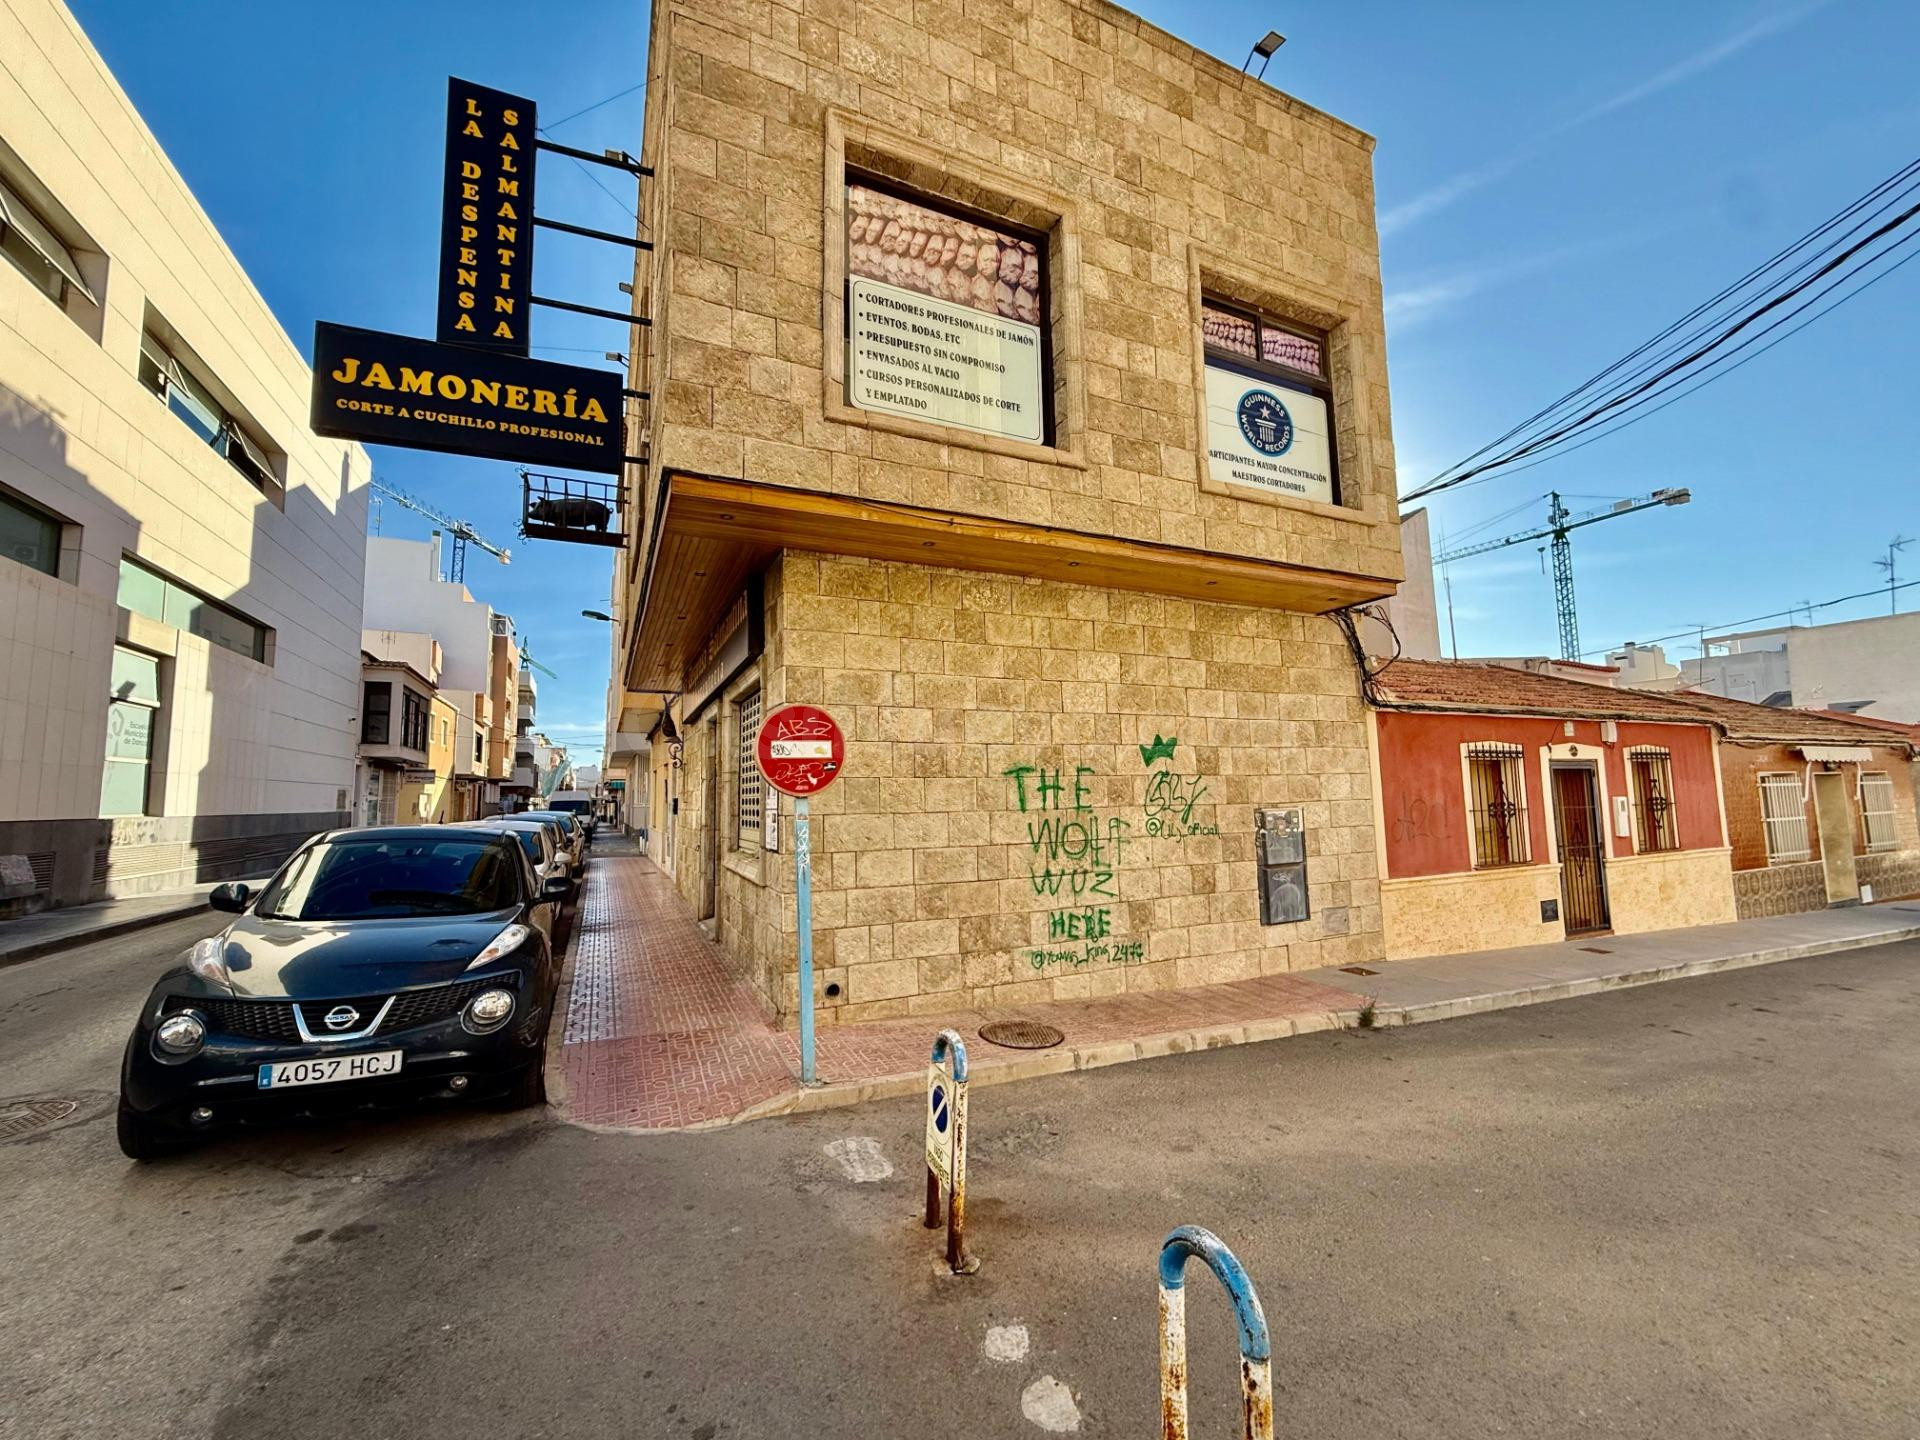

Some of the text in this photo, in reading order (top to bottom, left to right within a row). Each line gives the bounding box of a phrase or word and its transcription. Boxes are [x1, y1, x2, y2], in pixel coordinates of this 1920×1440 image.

[455, 98, 483, 333] LA DESPENSA
[494, 108, 520, 340] SALMANTINA
[866, 293, 1034, 347] CORTADORES PROFESIONALES DE JAMÓN
[866, 330, 1006, 374] PRESUPUESTO SIN COMPROMISO
[944, 332, 961, 345] ETC
[866, 350, 960, 381] ENVASADOS AL VACIO
[332, 357, 609, 424] JAMONERÍA
[865, 388, 928, 410] Y EMPLATADO
[866, 369, 1021, 413] CURSOS PERSONALIZADOS DE CORTE
[1244, 393, 1285, 418] GUINNESS
[335, 398, 605, 446] CORTE A CUCHILLO PROFESIONAL
[1241, 413, 1291, 453] WORLD RECORDS
[1231, 470, 1306, 493] MAESTROS CORTADORES
[1256, 460, 1278, 473] MAYOR
[1003, 765, 1095, 813] THE
[1030, 867, 1118, 897] WUZ
[1050, 906, 1111, 941] HERE
[325, 1013, 356, 1022] NISSAN
[277, 1054, 396, 1084] 4057 HCJ
